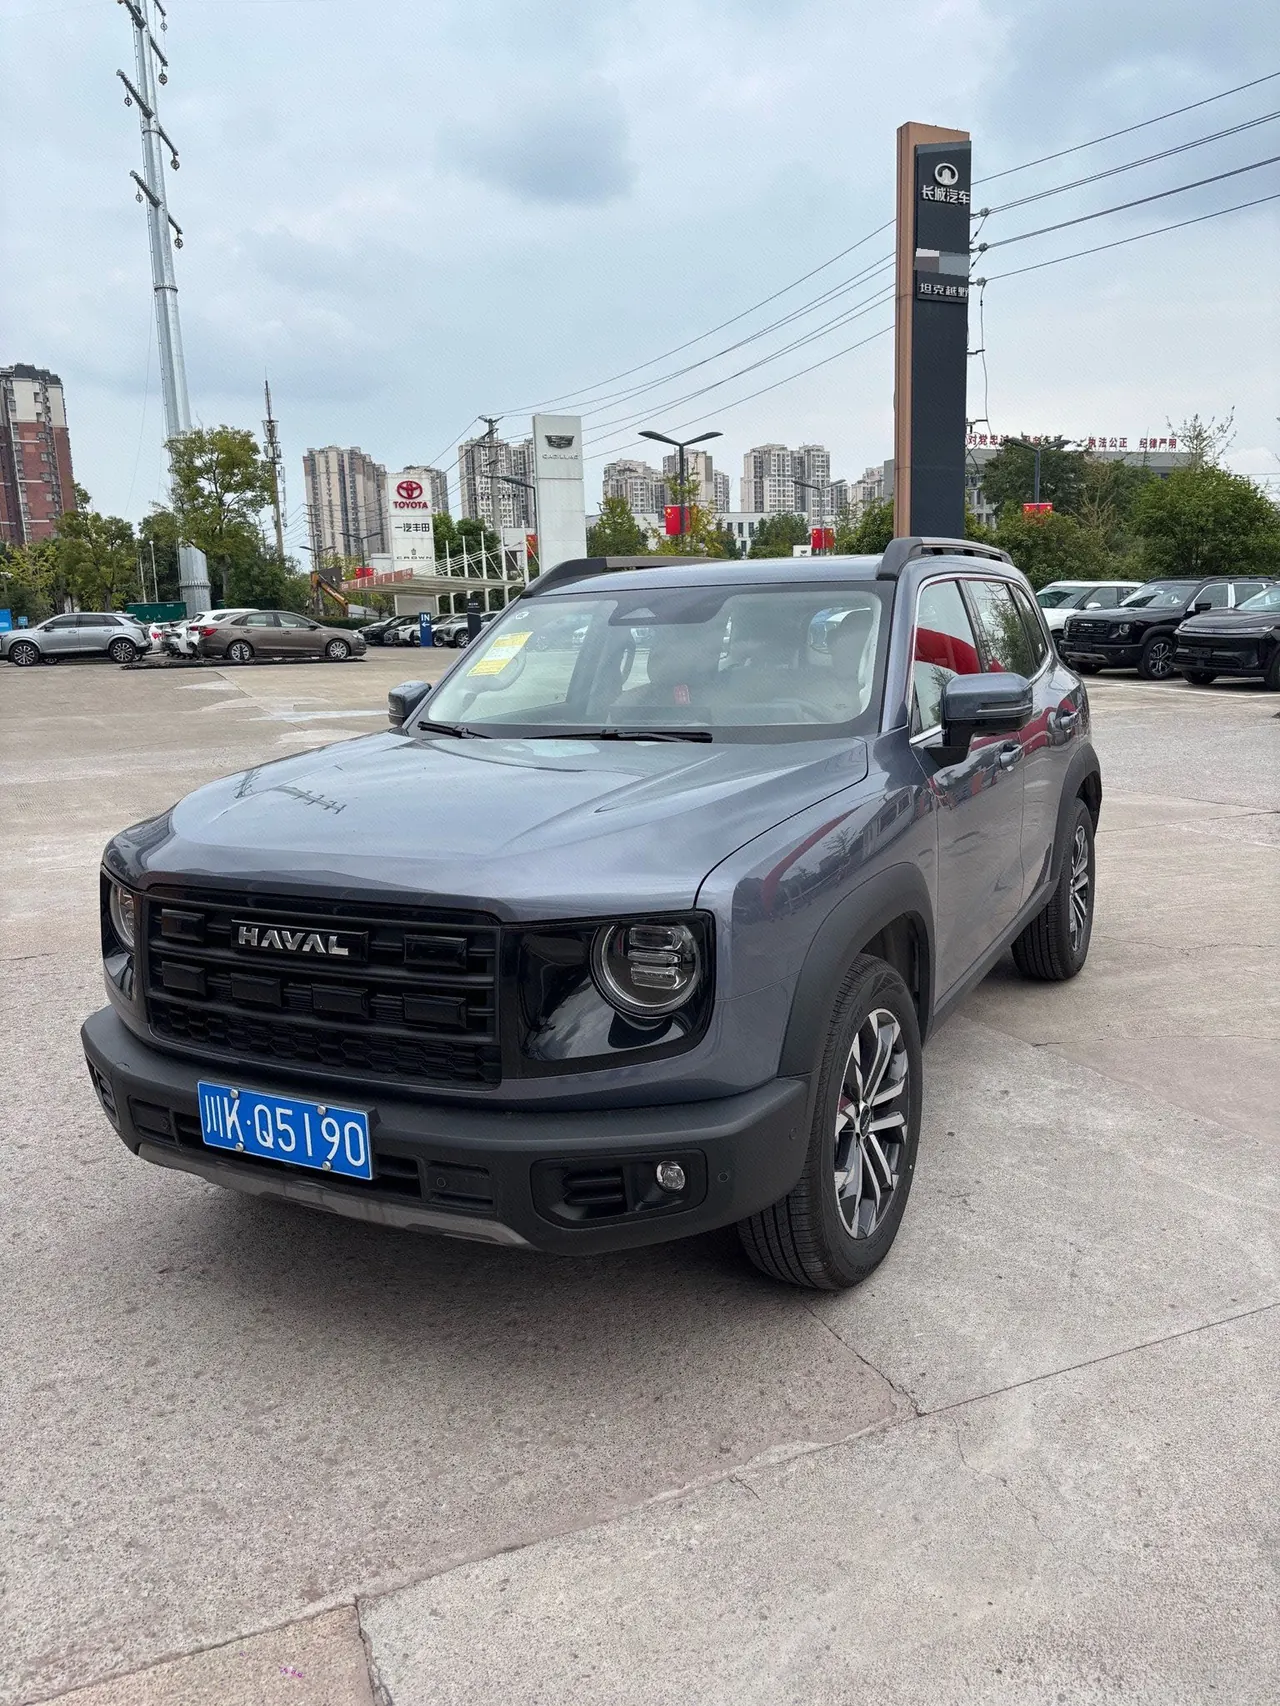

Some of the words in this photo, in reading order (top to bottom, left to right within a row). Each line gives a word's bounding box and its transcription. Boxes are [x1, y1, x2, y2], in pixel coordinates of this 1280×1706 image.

[921, 184, 970, 204] 长城汽车
[919, 282, 969, 298] 坦克越野
[1087, 436, 1128, 448] 执法公正
[1139, 437, 1177, 449] 纪律严明
[392, 500, 429, 510] TOYOTA
[394, 522, 430, 533] 一汽丰田
[420, 613, 430, 621] IN
[237, 925, 350, 956] HAVAL
